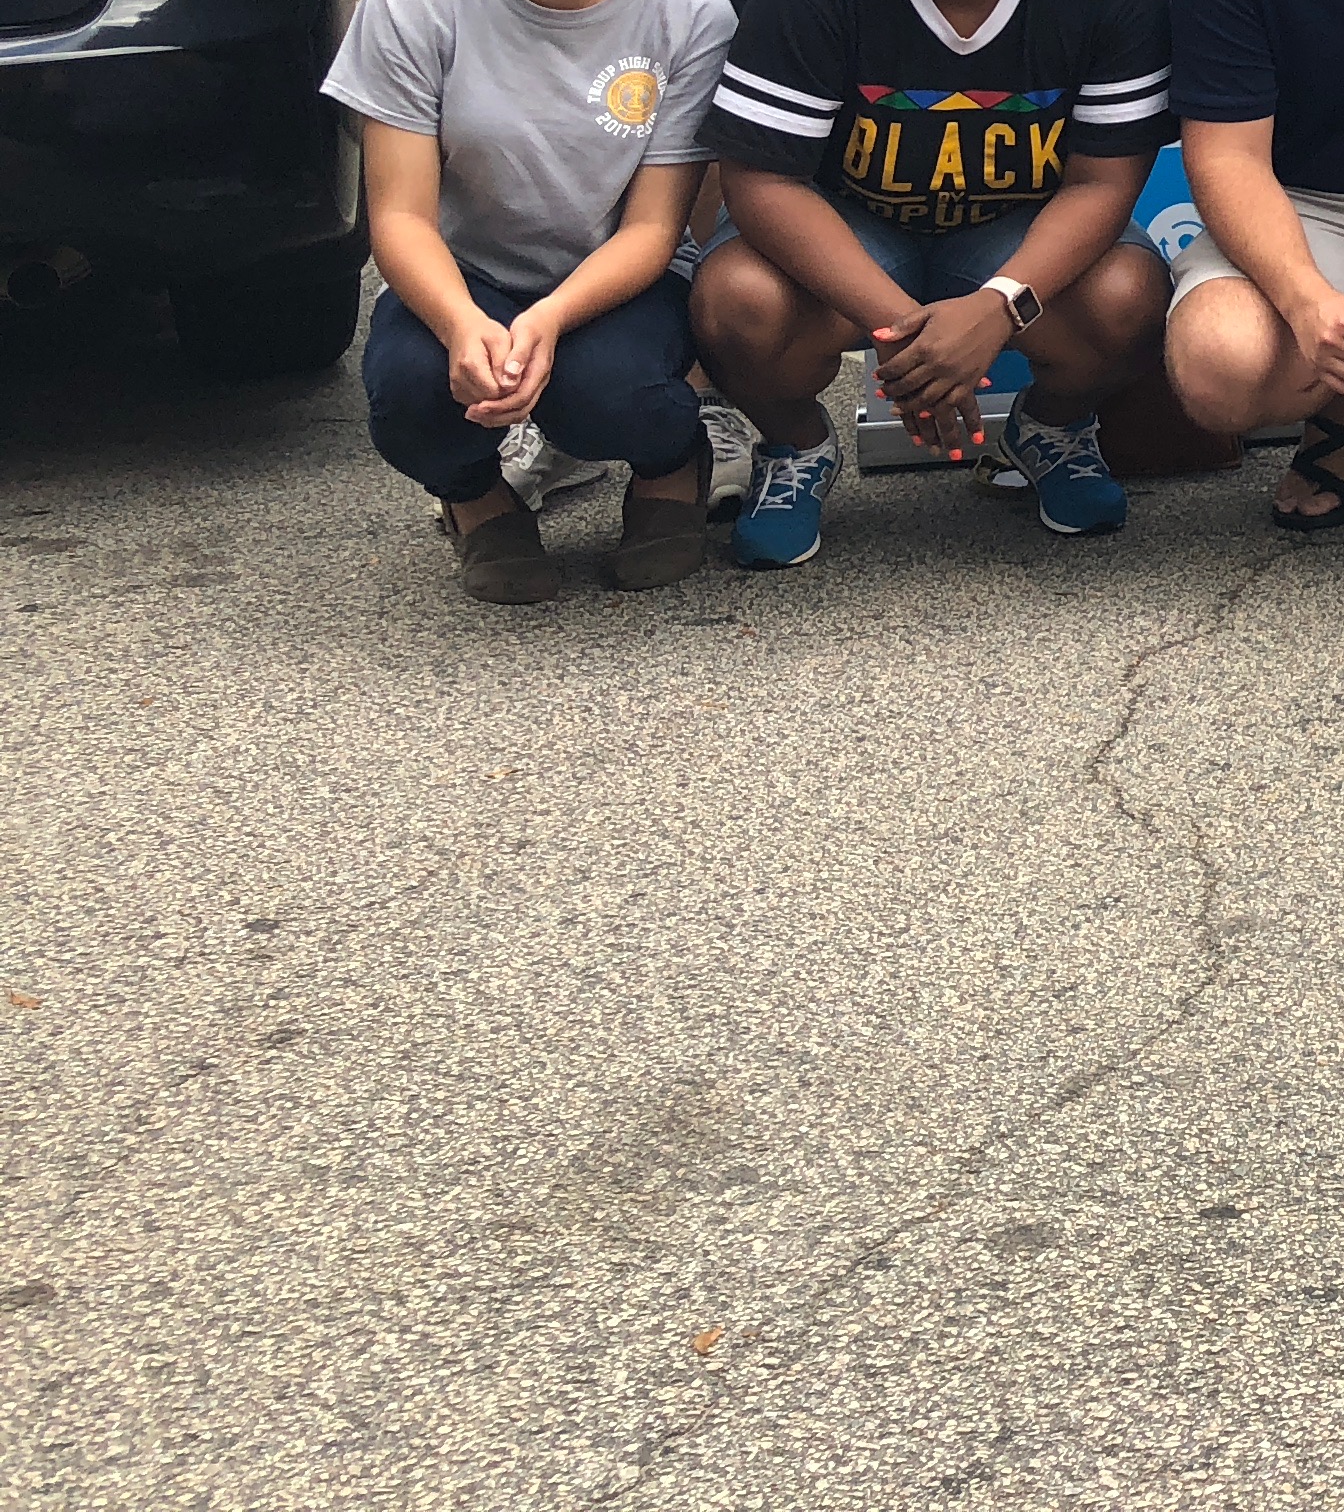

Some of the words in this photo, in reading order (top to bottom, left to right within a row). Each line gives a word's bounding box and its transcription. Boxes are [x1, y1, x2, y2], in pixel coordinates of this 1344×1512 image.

[586, 64, 616, 104] TROUP
[618, 55, 651, 71] HIGH
[842, 113, 1066, 191] BLACK
